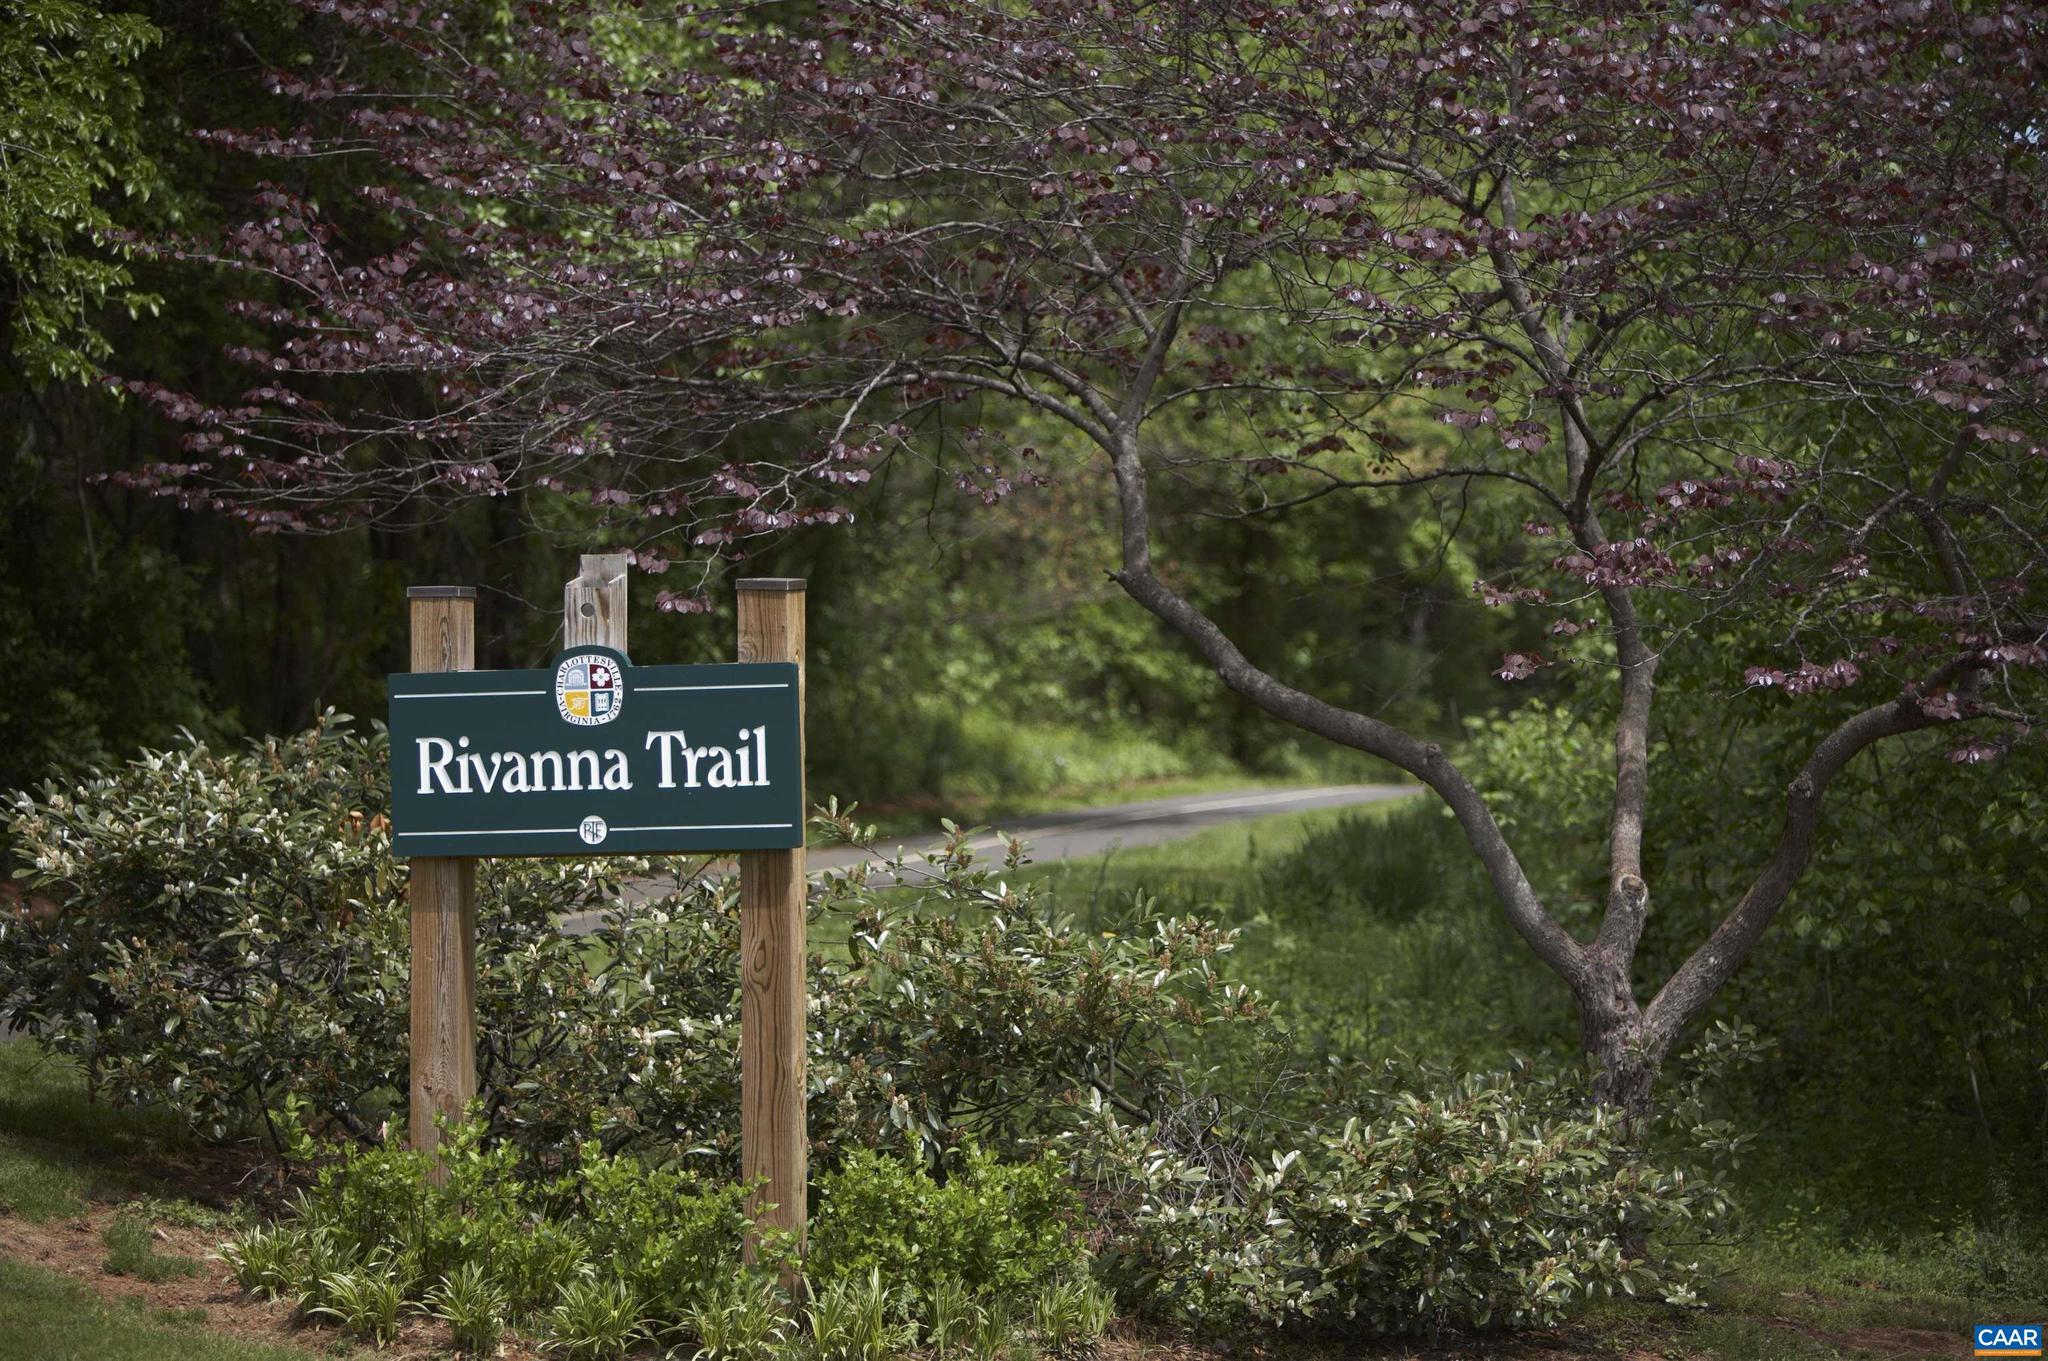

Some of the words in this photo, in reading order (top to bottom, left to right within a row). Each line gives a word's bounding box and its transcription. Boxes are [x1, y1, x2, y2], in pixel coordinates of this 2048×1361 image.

[557, 655, 622, 696] CHARLOTTESVILLE
[559, 700, 600, 725] VIRGINIA
[607, 698, 622, 720] 1762
[415, 735, 634, 795] Rivanna
[645, 725, 771, 790] Trail
